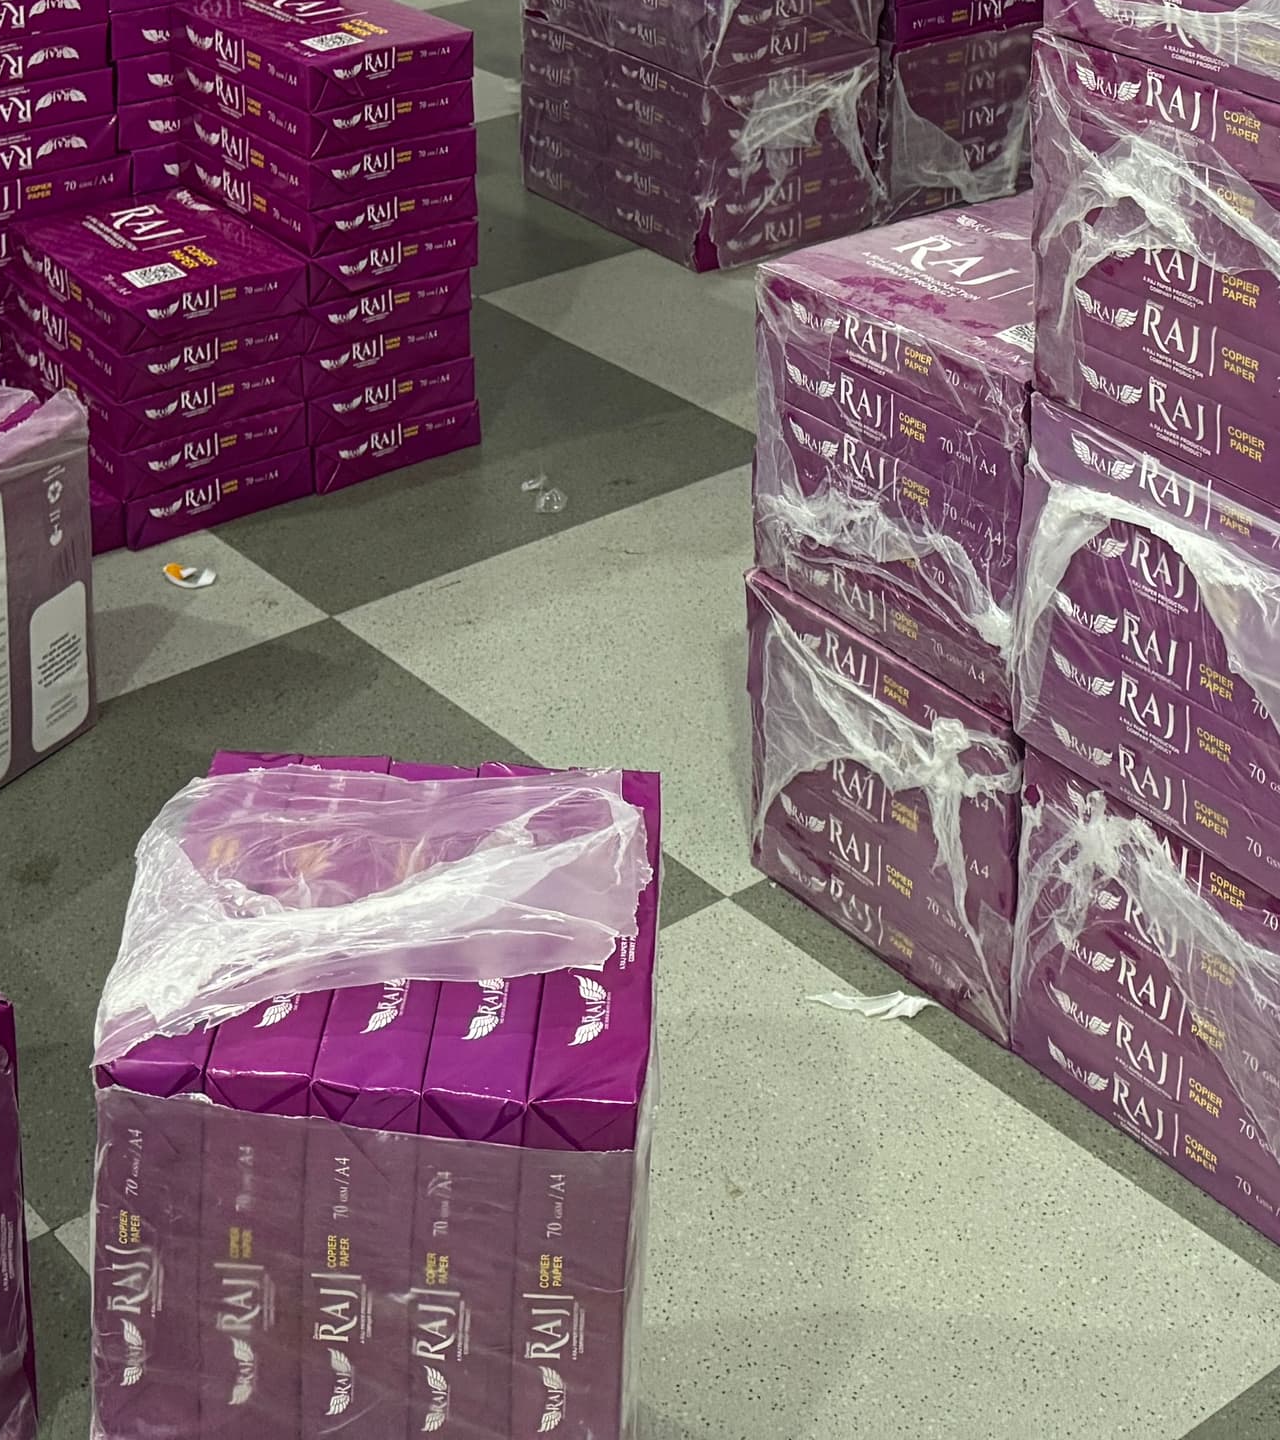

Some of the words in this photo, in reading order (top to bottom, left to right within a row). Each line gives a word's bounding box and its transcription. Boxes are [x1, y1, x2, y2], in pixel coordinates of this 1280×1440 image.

[894, 235, 1021, 286] RAJ
[182, 291, 211, 311] RAJ
[840, 377, 882, 428] RAJ
[1148, 383, 1205, 442] RAJ
[899, 411, 928, 433] COPIER
[899, 425, 926, 443] PAPER
[1228, 426, 1266, 451] COPIER
[1229, 440, 1263, 463] PAPER
[1184, 1133, 1218, 1161] COPIER
[1185, 1148, 1217, 1173] PAPER
[1234, 1175, 1252, 1198] 70
[326, 1234, 338, 1269] COPIER
[339, 1237, 349, 1268] PAPER
[320, 1285, 359, 1345] RAJ
[531, 1308, 572, 1361] RAJ
